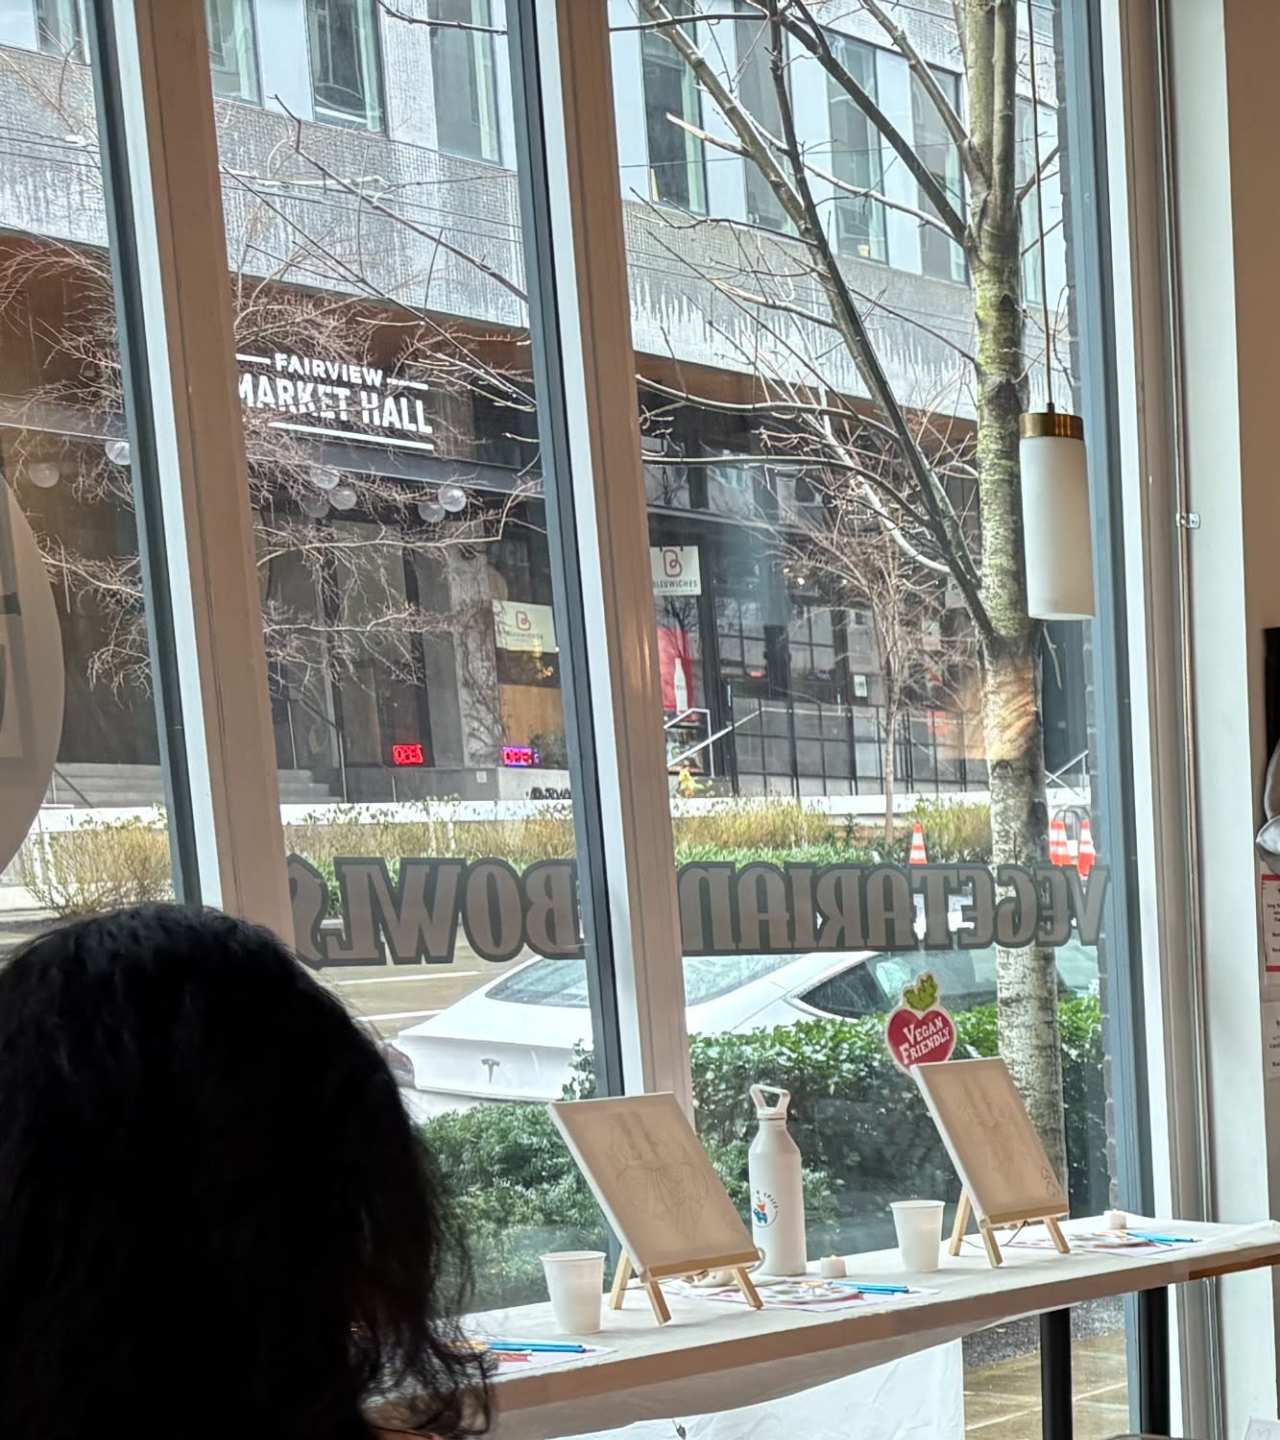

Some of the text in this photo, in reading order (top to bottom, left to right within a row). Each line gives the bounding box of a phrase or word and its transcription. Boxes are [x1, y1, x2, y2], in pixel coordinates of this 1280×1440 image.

[274, 353, 383, 387] FAIRVIEW
[239, 373, 433, 434] MARKET HALL
[899, 1027, 950, 1065] FRIENDLY
[903, 1016, 944, 1046] VEGAN
